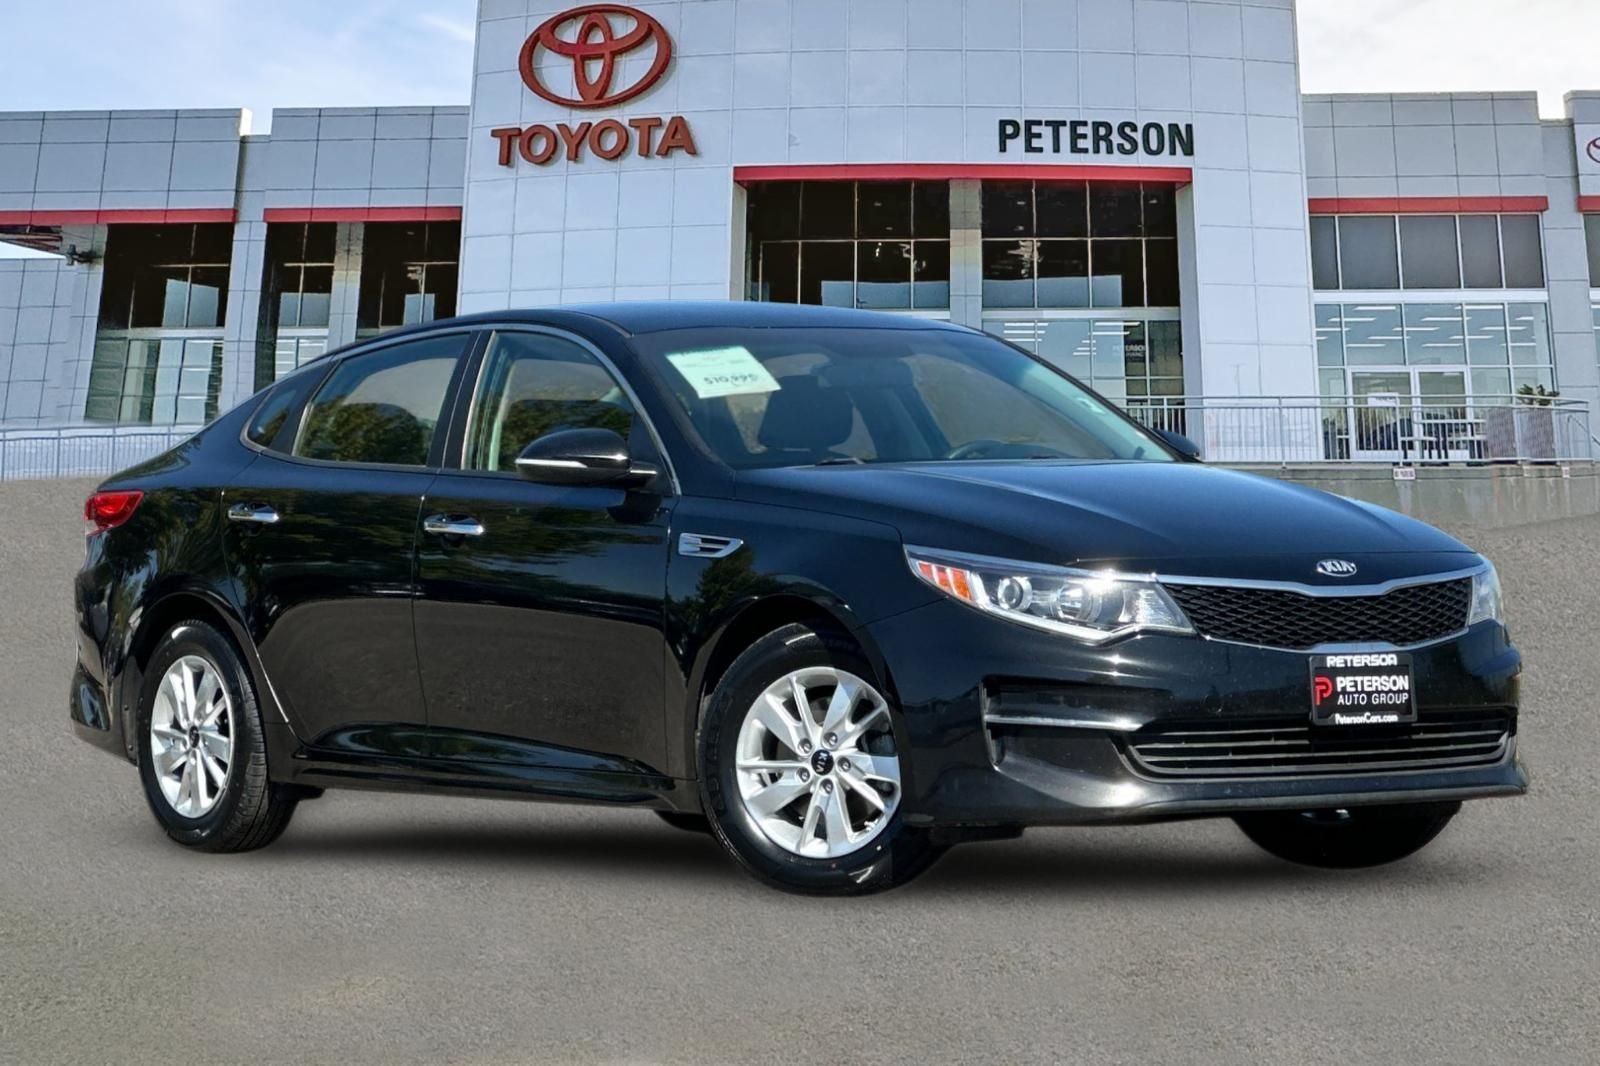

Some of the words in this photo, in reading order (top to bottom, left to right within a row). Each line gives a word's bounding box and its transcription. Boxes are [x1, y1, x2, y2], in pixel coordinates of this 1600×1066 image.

[491, 116, 697, 167] TOYOTA
[998, 119, 1194, 156] PETERSON
[1319, 560, 1356, 573] KIA
[1336, 675, 1409, 692] PETERSON
[1337, 694, 1368, 706] AUTO
[1371, 693, 1409, 705] GROUP
[1335, 712, 1399, 725] PetersonCars.com
